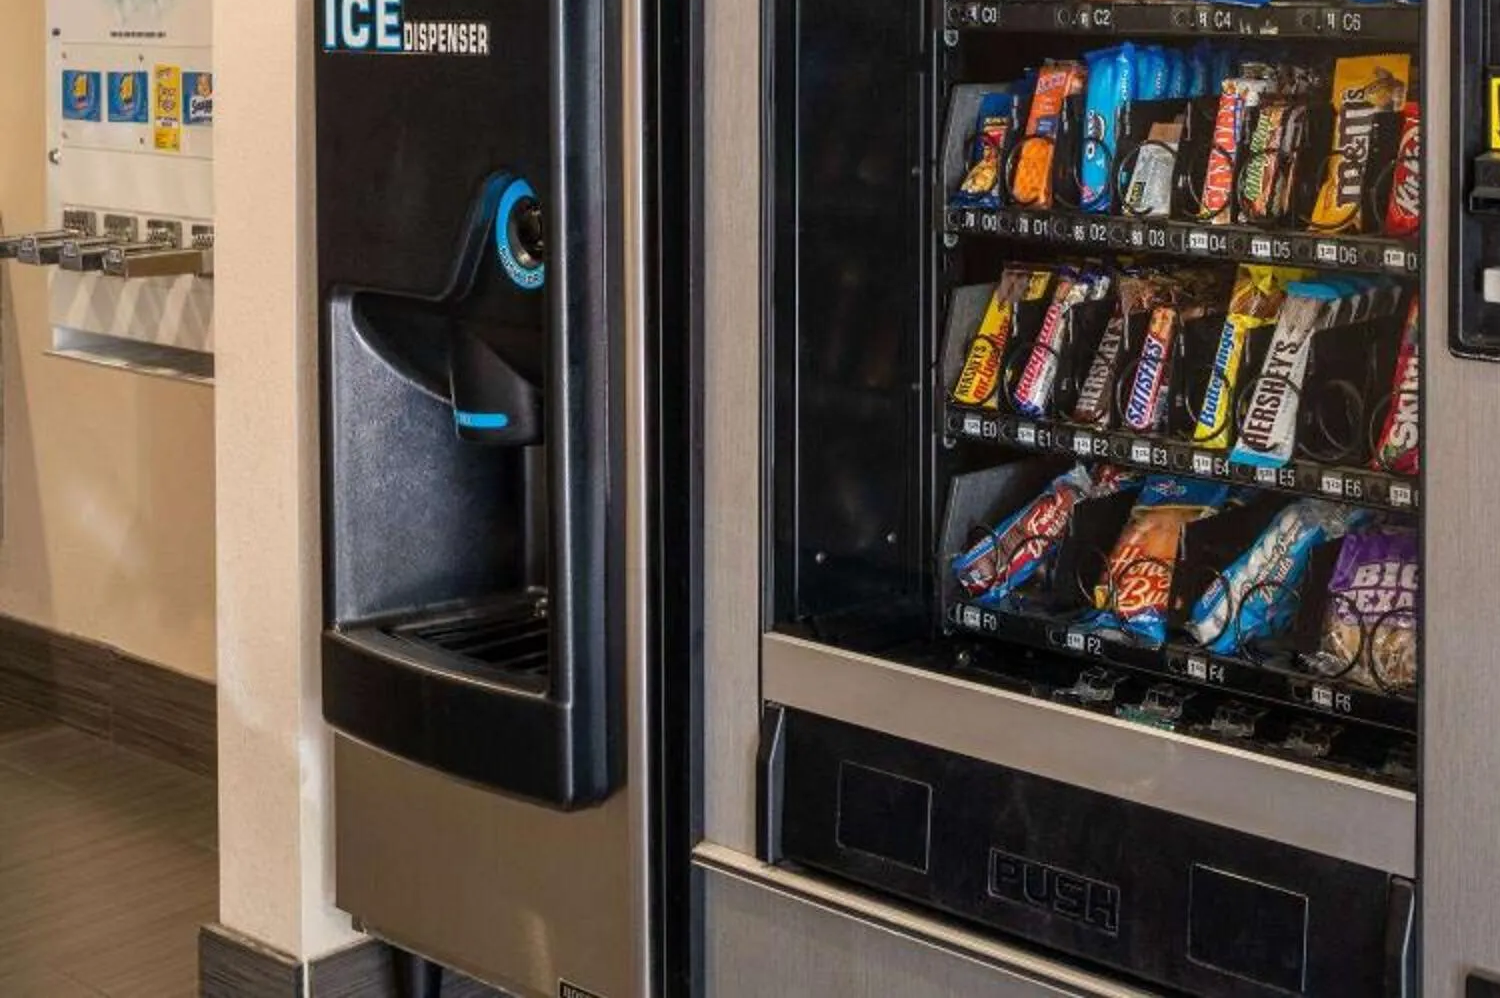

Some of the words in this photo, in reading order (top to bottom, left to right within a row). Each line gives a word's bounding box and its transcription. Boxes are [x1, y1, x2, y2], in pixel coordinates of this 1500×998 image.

[403, 21, 489, 55] DISPENSER
[1244, 339, 1301, 451] HERSHEY'S
[1339, 588, 1414, 613] TEXA
[992, 852, 1117, 931] PUSH
